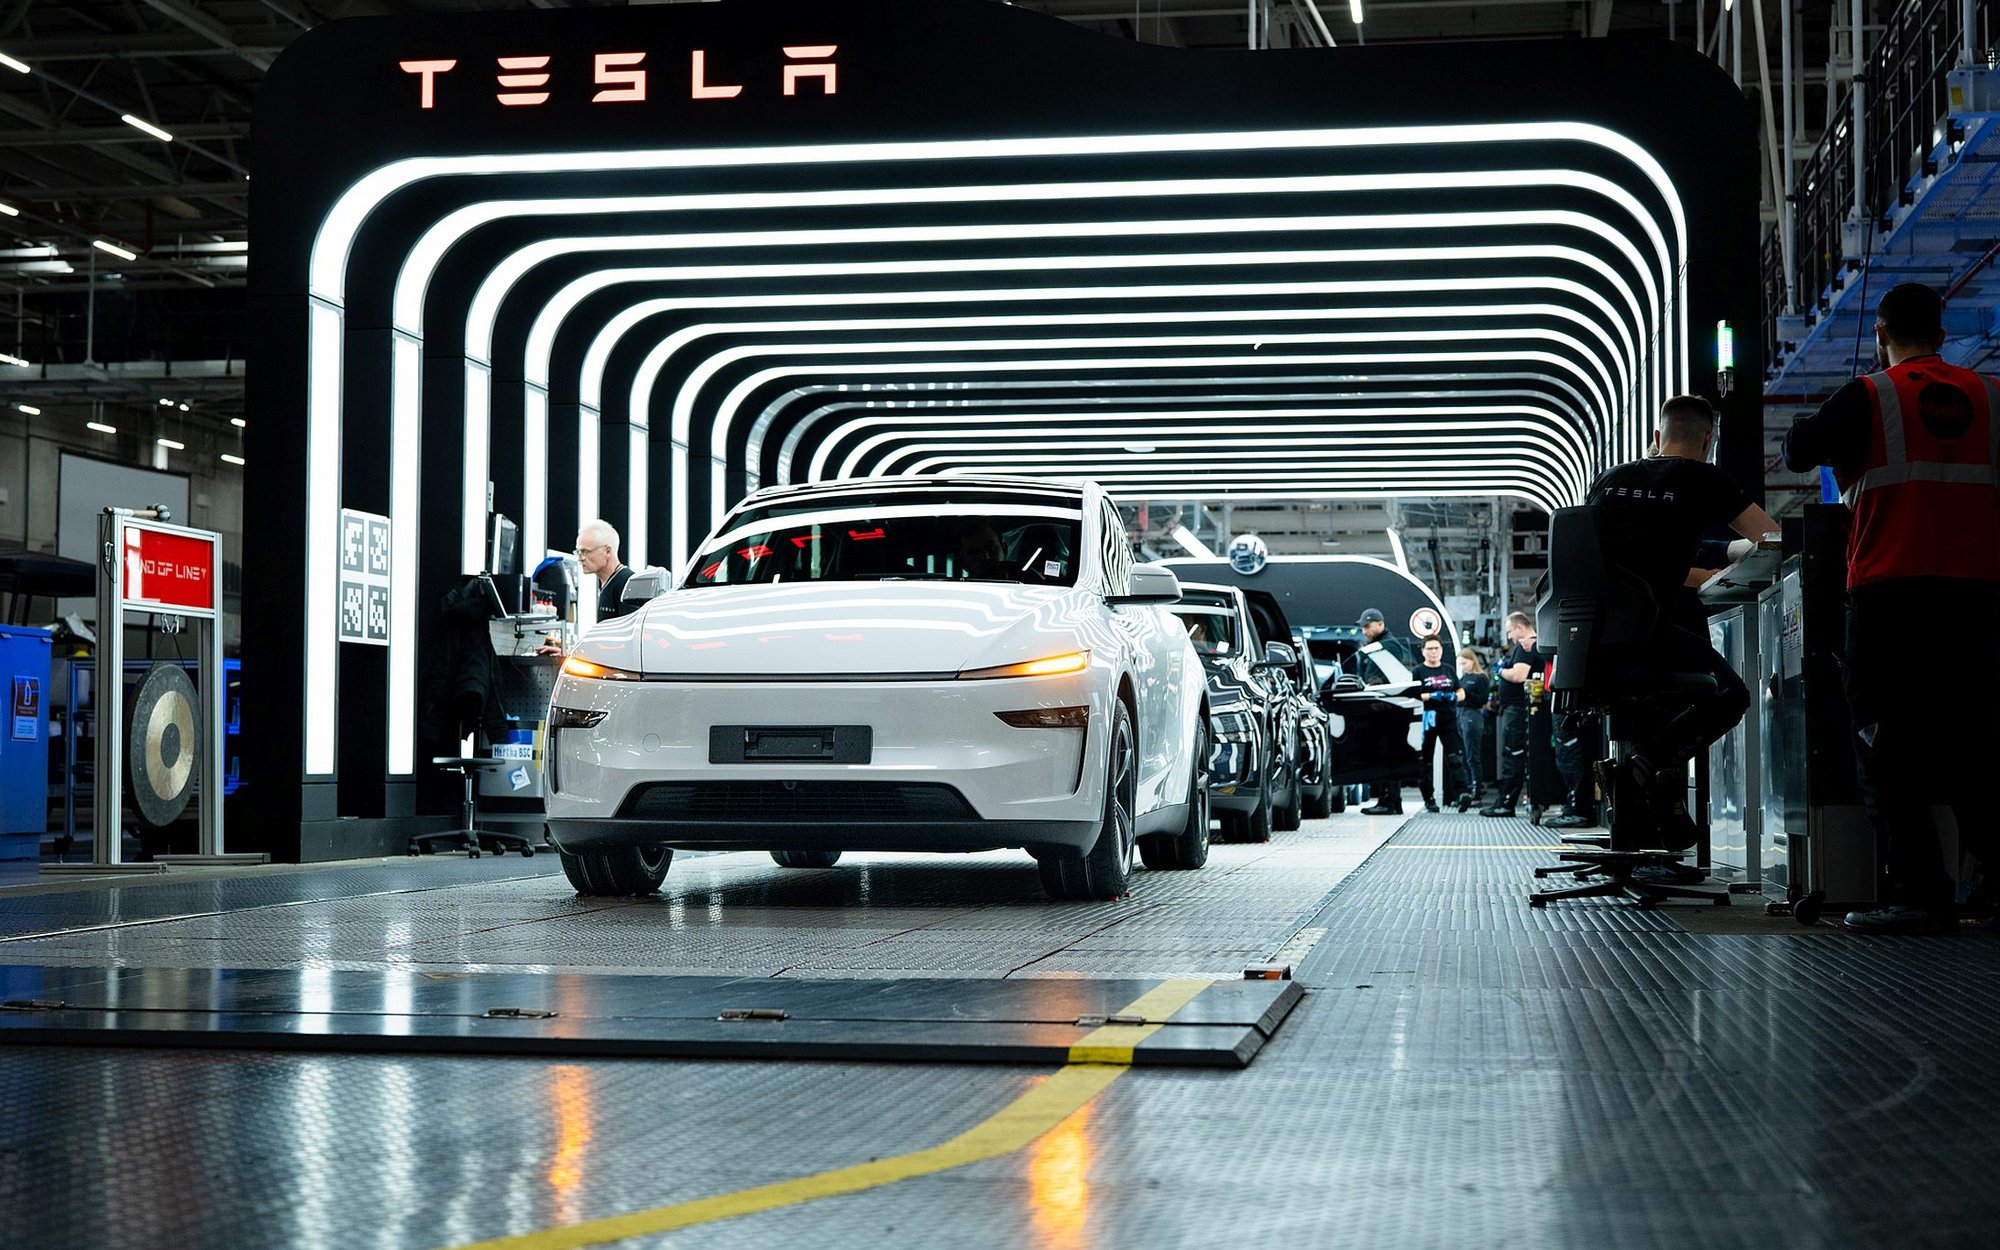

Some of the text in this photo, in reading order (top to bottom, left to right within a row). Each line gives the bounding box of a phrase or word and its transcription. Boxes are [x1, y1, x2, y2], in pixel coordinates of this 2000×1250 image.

[399, 45, 837, 108] TESLA
[1604, 487, 1674, 501] TESLA
[138, 558, 200, 580] ND OF LINE
